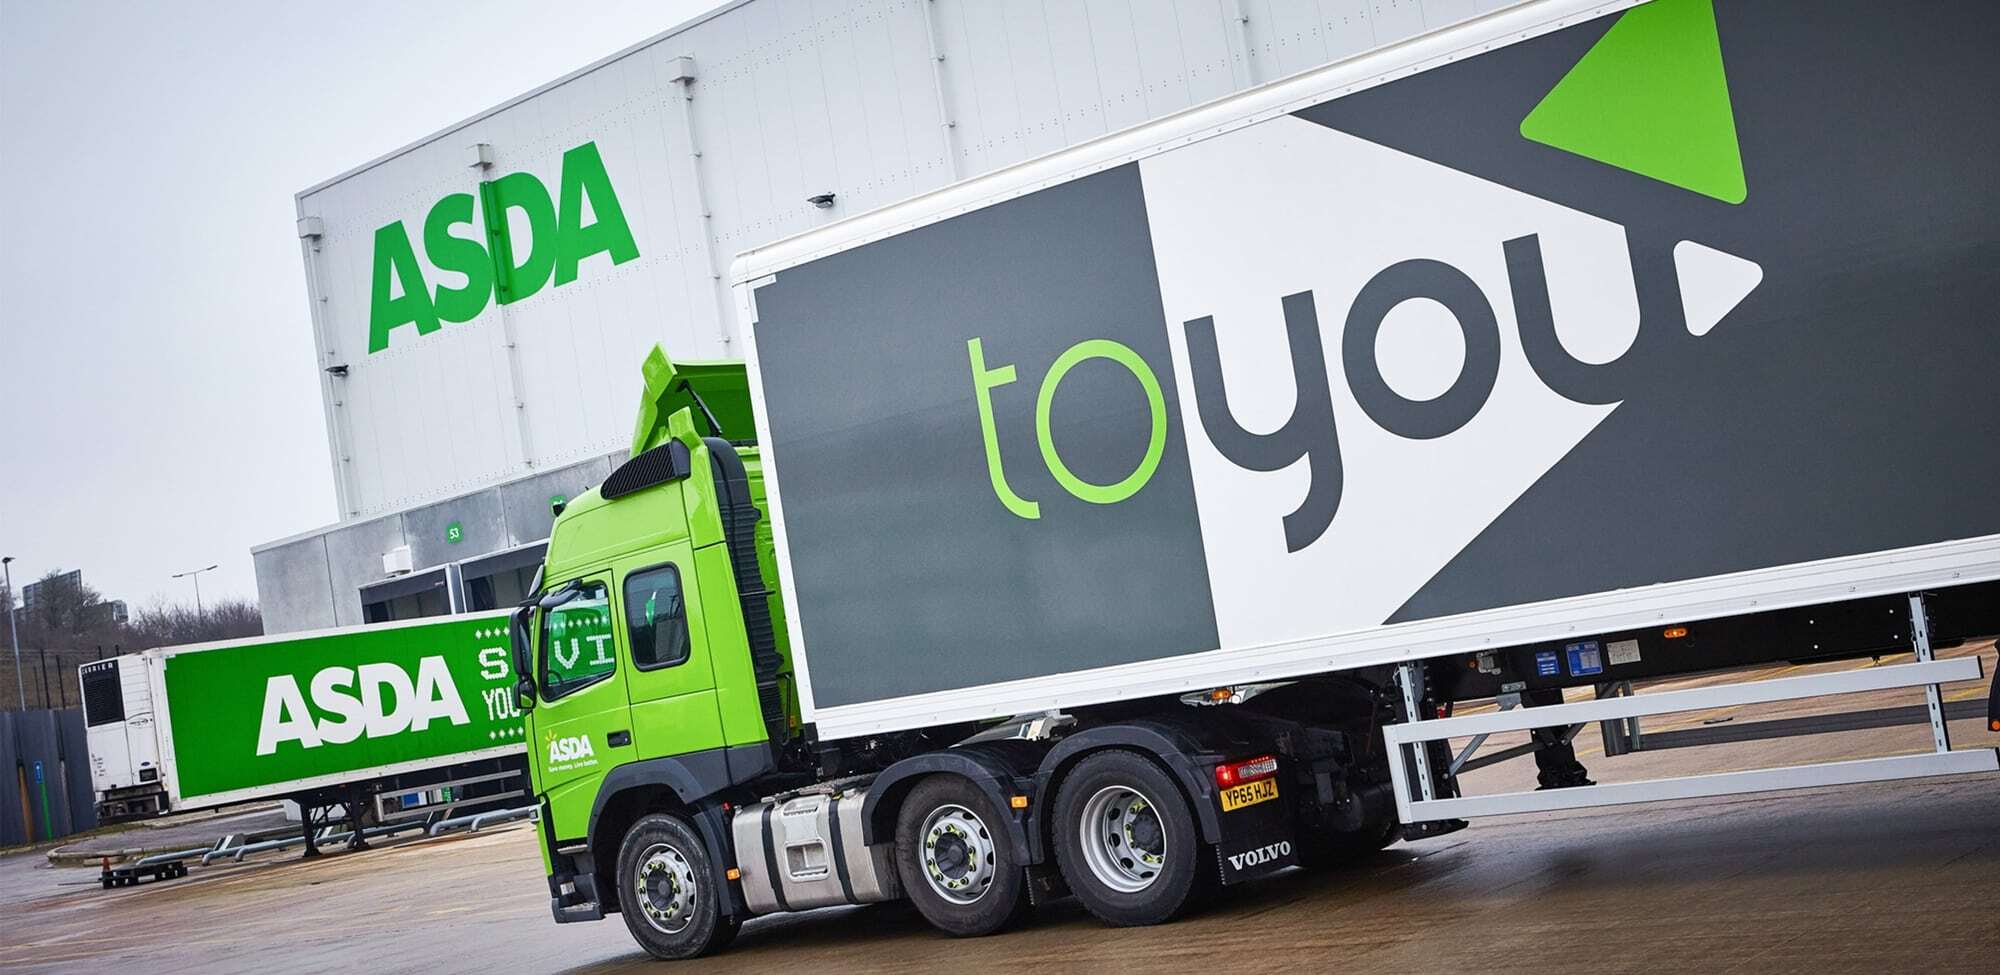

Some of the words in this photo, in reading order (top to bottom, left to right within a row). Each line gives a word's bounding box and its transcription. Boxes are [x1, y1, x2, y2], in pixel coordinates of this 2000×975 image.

[368, 141, 640, 355] ASDA
[449, 527, 460, 539] 53
[256, 656, 470, 756] ASDA
[550, 735, 594, 763] ASDA
[1226, 785, 1253, 807] YP65
[1255, 781, 1274, 799] HJZ
[1228, 841, 1291, 871] VOLVO
